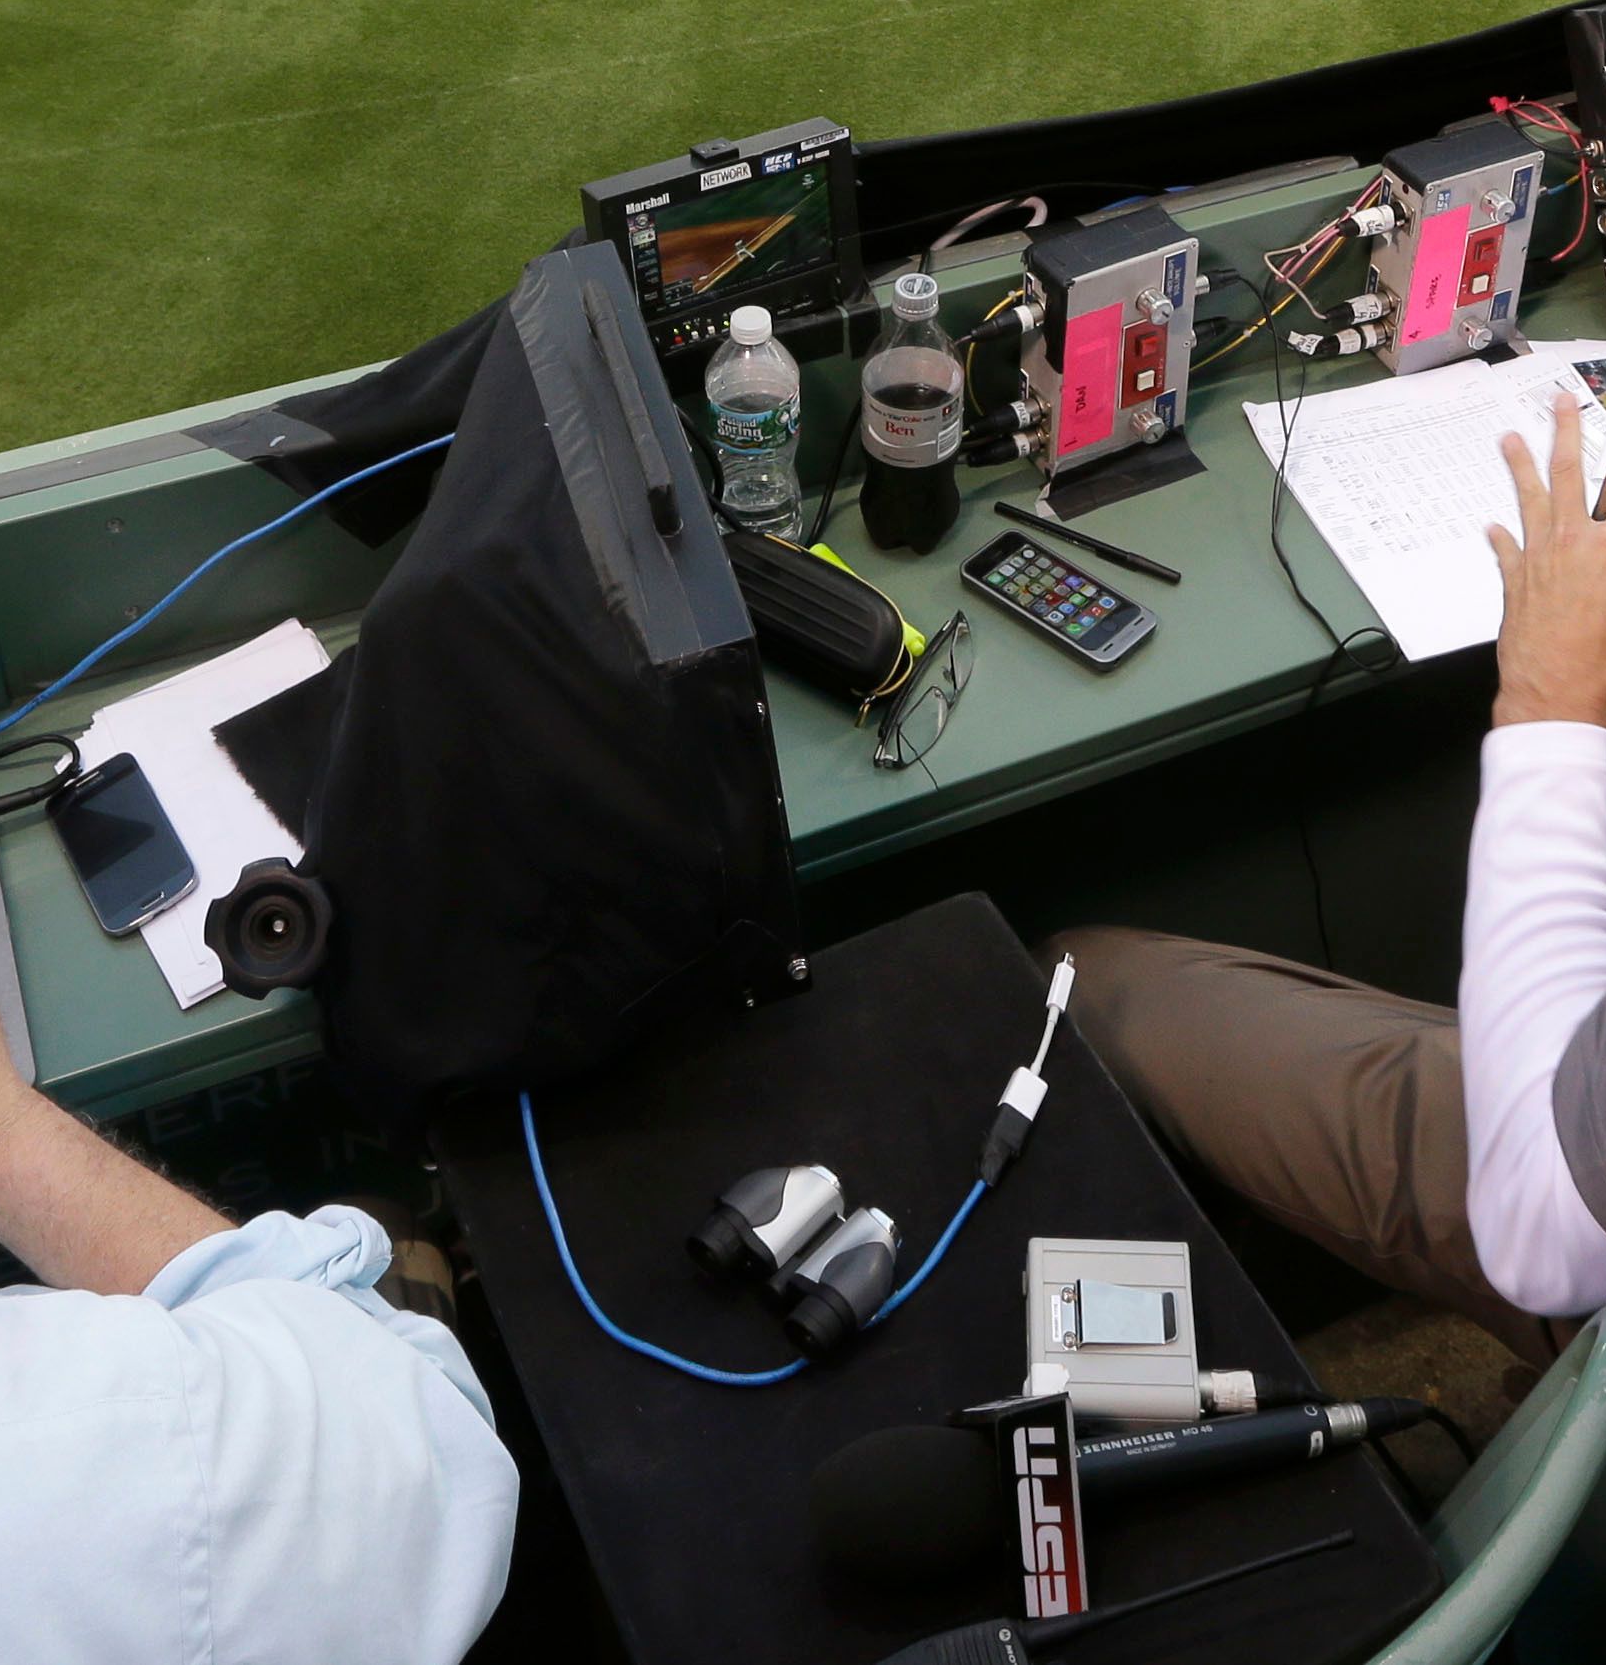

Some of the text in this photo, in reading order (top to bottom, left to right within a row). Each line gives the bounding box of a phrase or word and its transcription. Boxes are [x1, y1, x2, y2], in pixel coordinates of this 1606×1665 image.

[702, 166, 750, 187] NETWORK
[625, 192, 671, 216] Marshall
[1075, 385, 1087, 414] DAN
[717, 420, 763, 443] Spring
[885, 421, 916, 437] Ben
[1082, 1430, 1177, 1455] SENNHEISER
[1181, 1428, 1199, 1437] MD
[1013, 1426, 1069, 1618] ESPN
